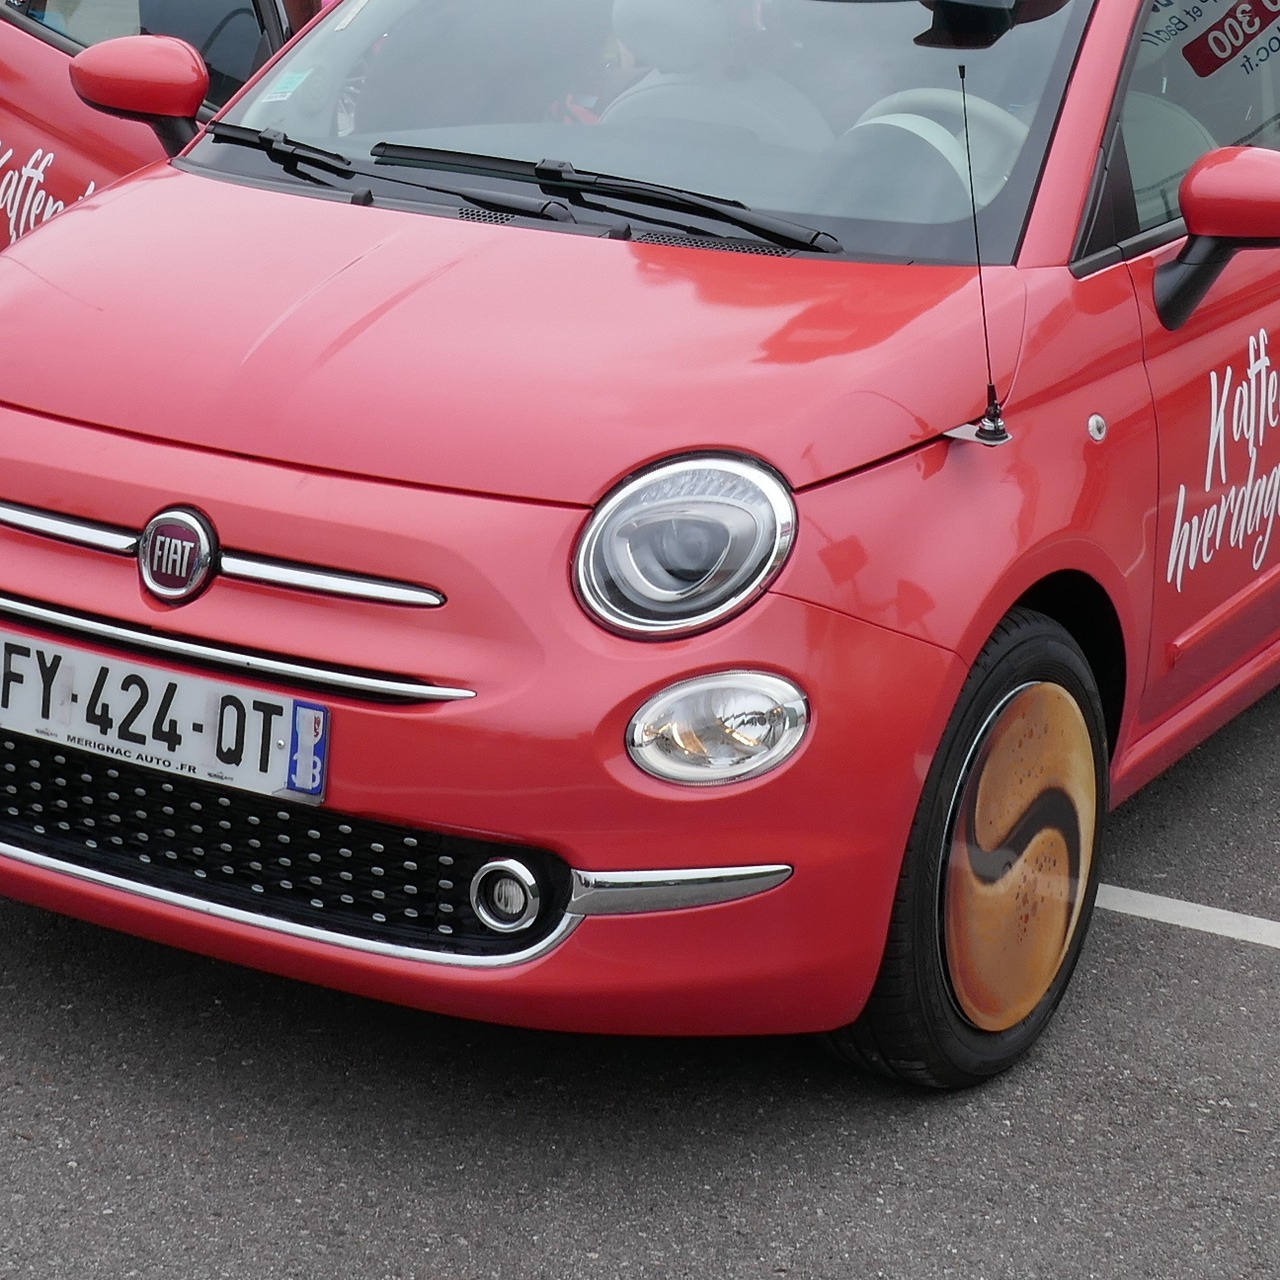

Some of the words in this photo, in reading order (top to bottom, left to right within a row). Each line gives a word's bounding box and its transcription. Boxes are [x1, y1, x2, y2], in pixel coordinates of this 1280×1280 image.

[152, 535, 196, 578] FIAT
[66, 733, 132, 759] MERIGNAC
[135, 752, 172, 768] AUTO
